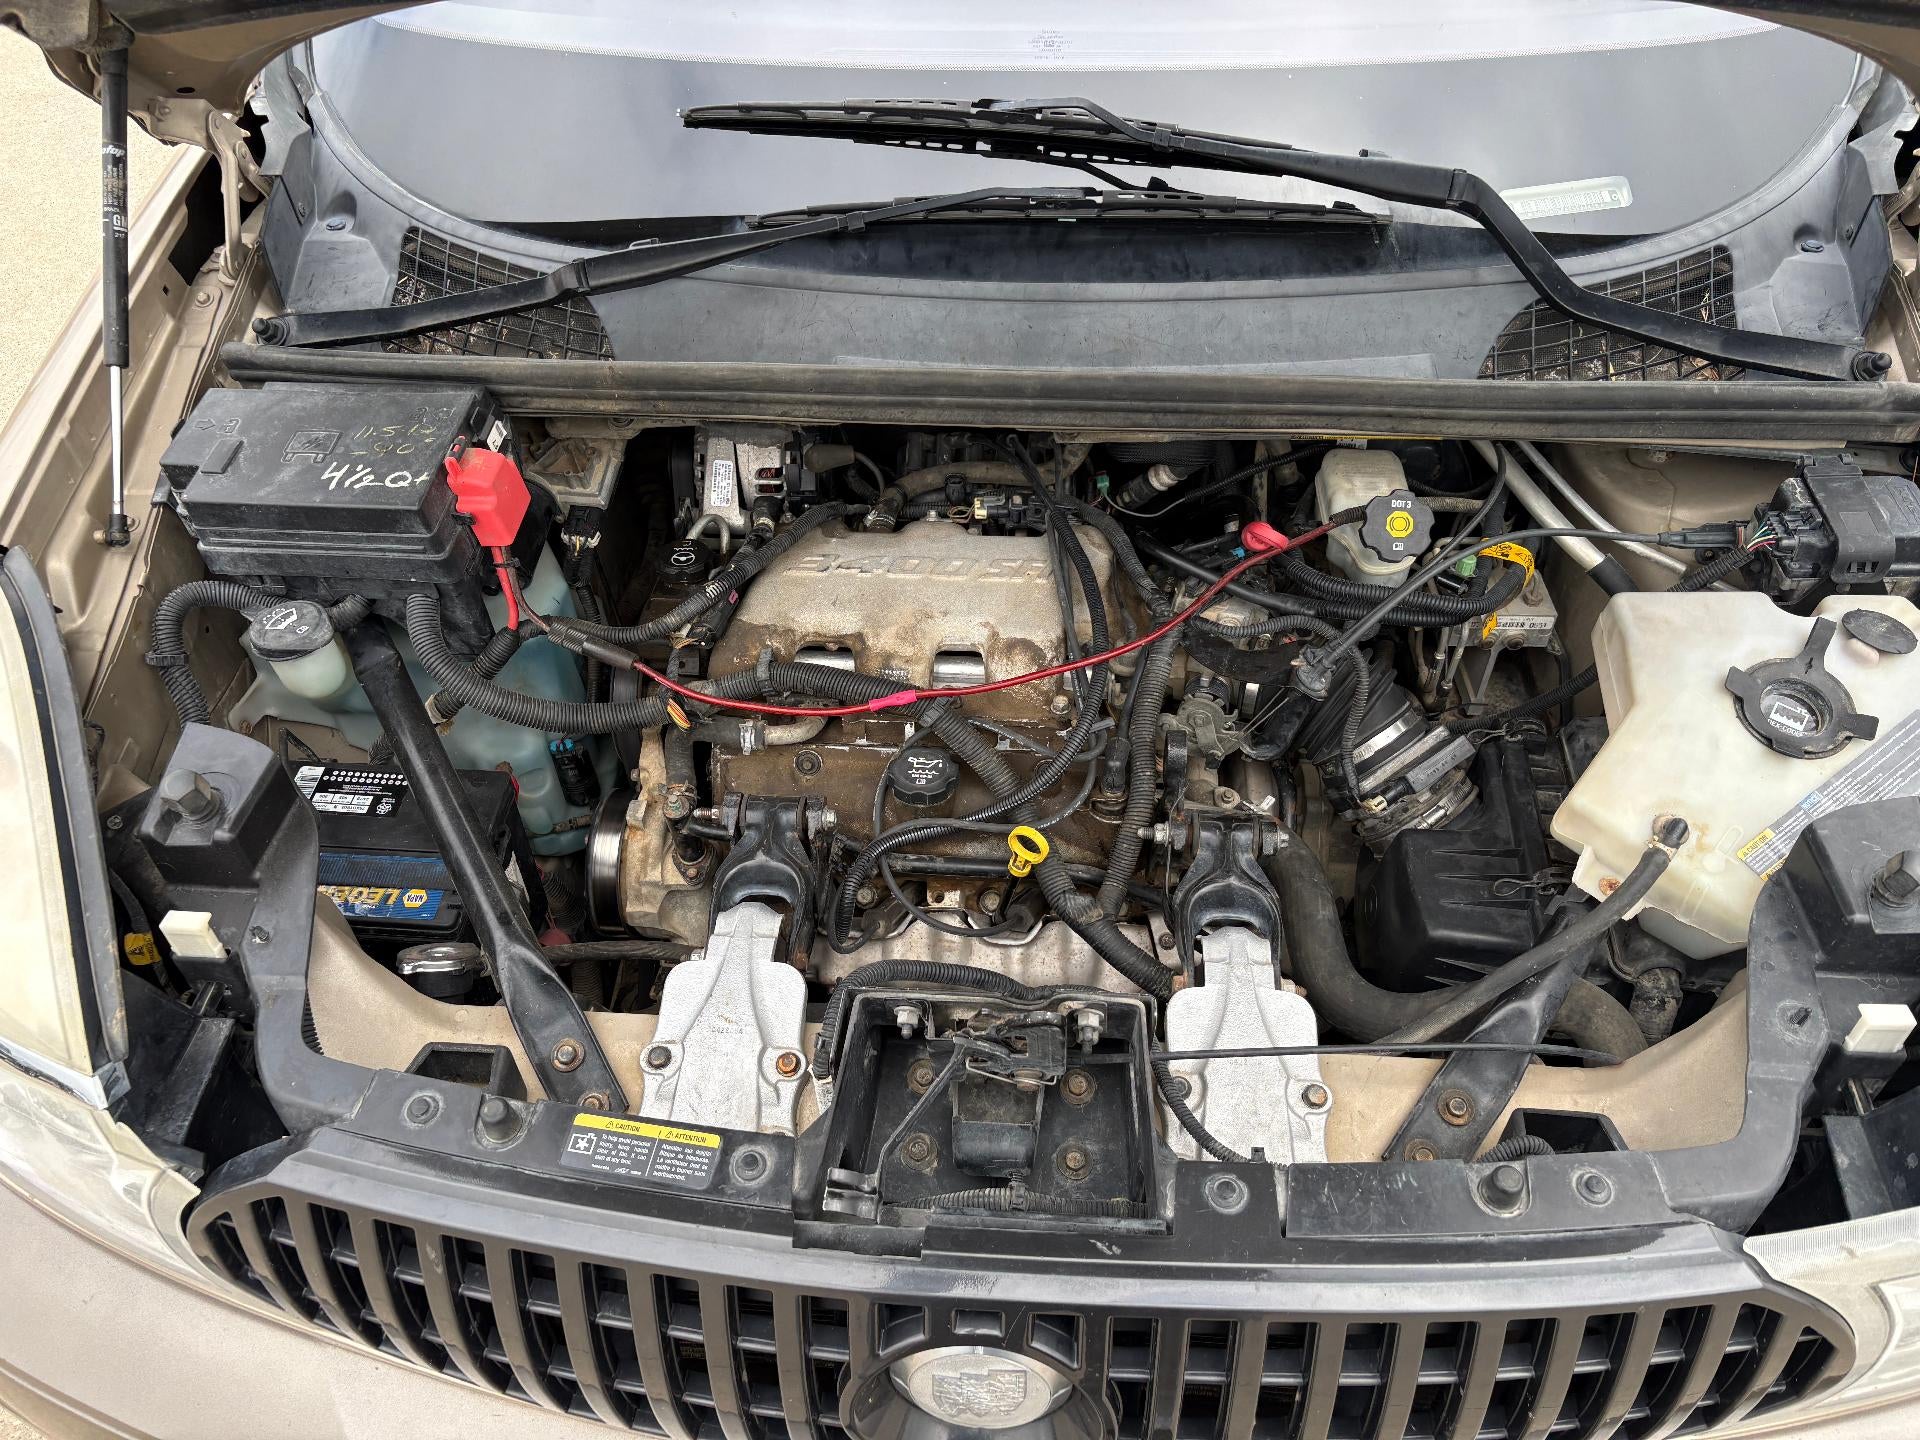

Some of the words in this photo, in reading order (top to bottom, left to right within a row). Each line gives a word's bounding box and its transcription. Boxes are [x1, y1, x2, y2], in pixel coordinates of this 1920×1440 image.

[1391, 500, 1406, 508] DOT
[1407, 501, 1412, 509] 3
[406, 894, 424, 903] NAPA
[615, 1123, 640, 1132] CAUTION
[675, 1132, 707, 1143] ATTENTION
